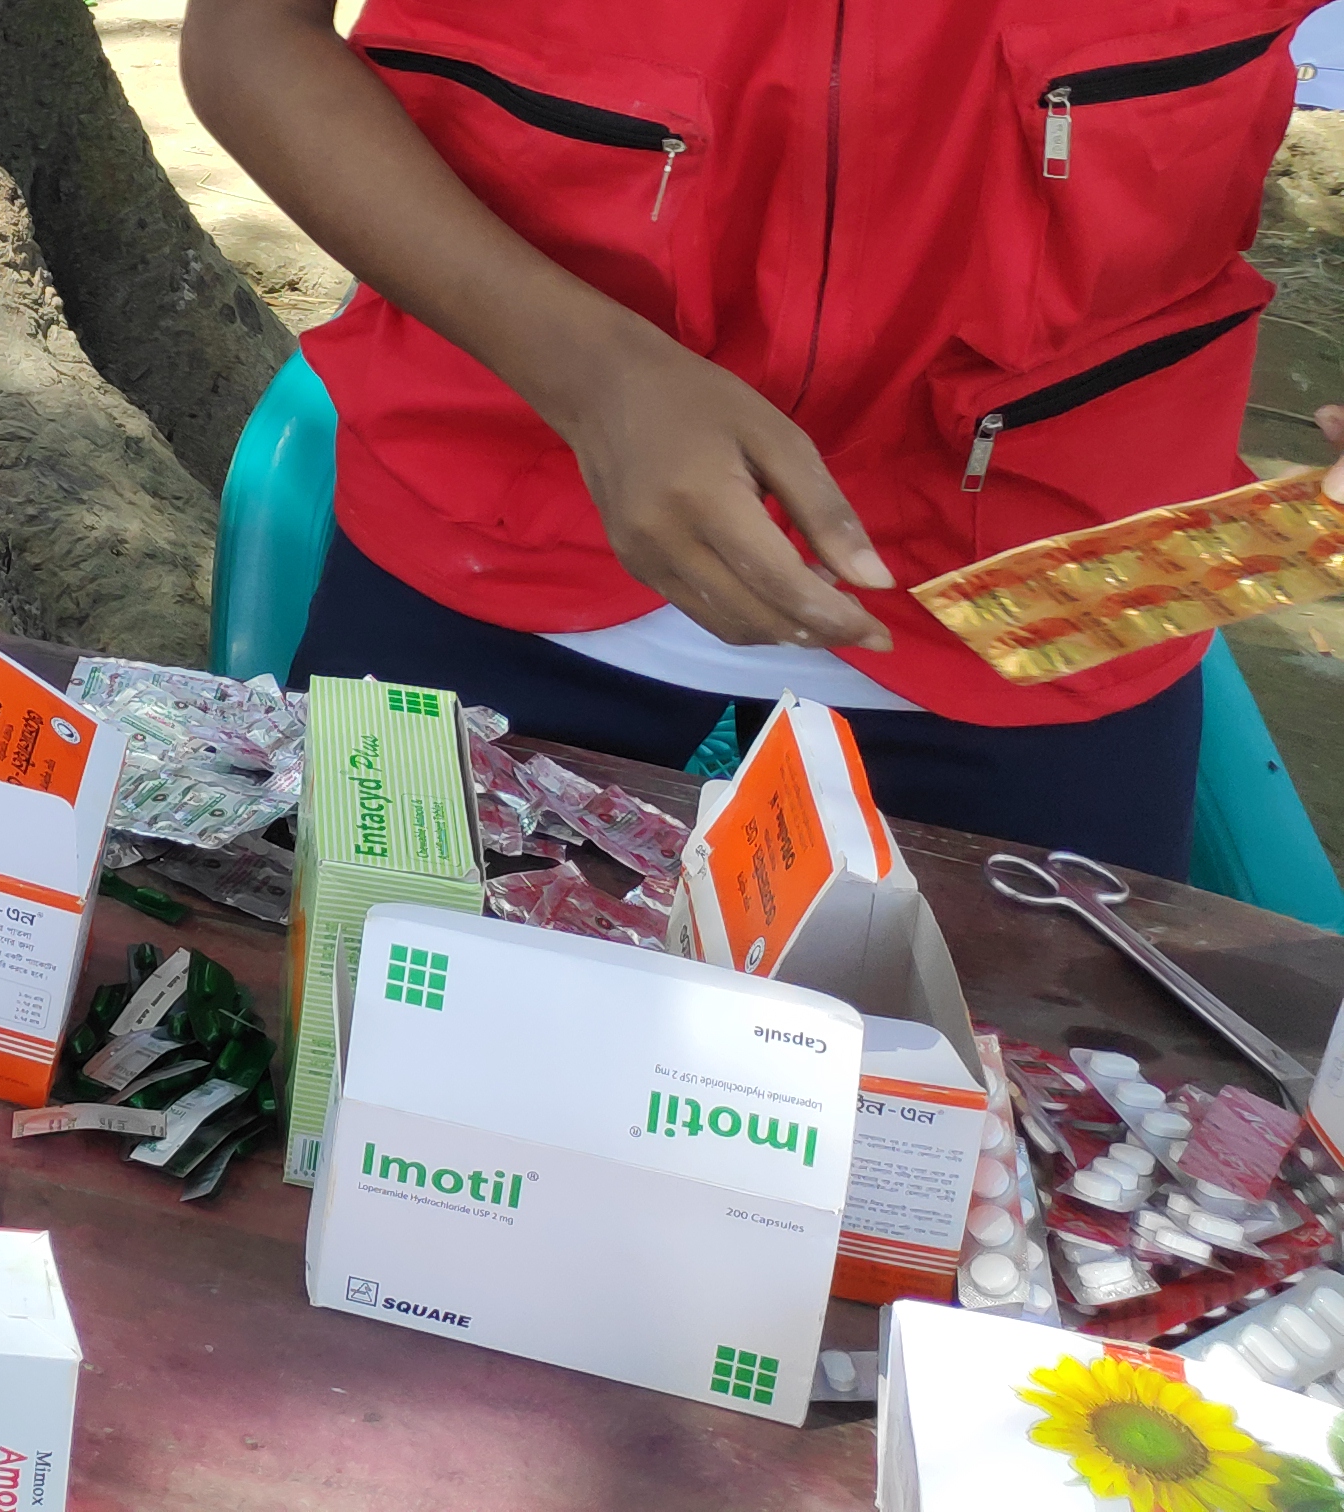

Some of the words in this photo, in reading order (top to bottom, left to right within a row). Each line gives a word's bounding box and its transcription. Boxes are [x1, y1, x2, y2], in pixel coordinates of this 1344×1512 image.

[349, 733, 383, 772] Plus
[348, 776, 394, 858] Entacyd
[753, 1025, 828, 1054] Capsule
[654, 1063, 671, 1077] mg
[671, 1069, 678, 1080] 2
[679, 1071, 699, 1085] USP
[699, 1075, 766, 1101] Hydrochloride
[766, 1089, 823, 1112] Loperamide
[646, 1090, 819, 1168] Imotil
[361, 1141, 523, 1210] Imotil
[357, 1181, 409, 1201] Loperamide
[410, 1192, 471, 1216] Hydrochloride
[472, 1207, 491, 1218] USP
[491, 1212, 498, 1221] 2
[499, 1214, 514, 1226] mg
[725, 1207, 749, 1220] 200
[750, 1213, 806, 1234] Capsules
[381, 1296, 473, 1329] SQUARE
[32, 1449, 54, 1507] Mimox
